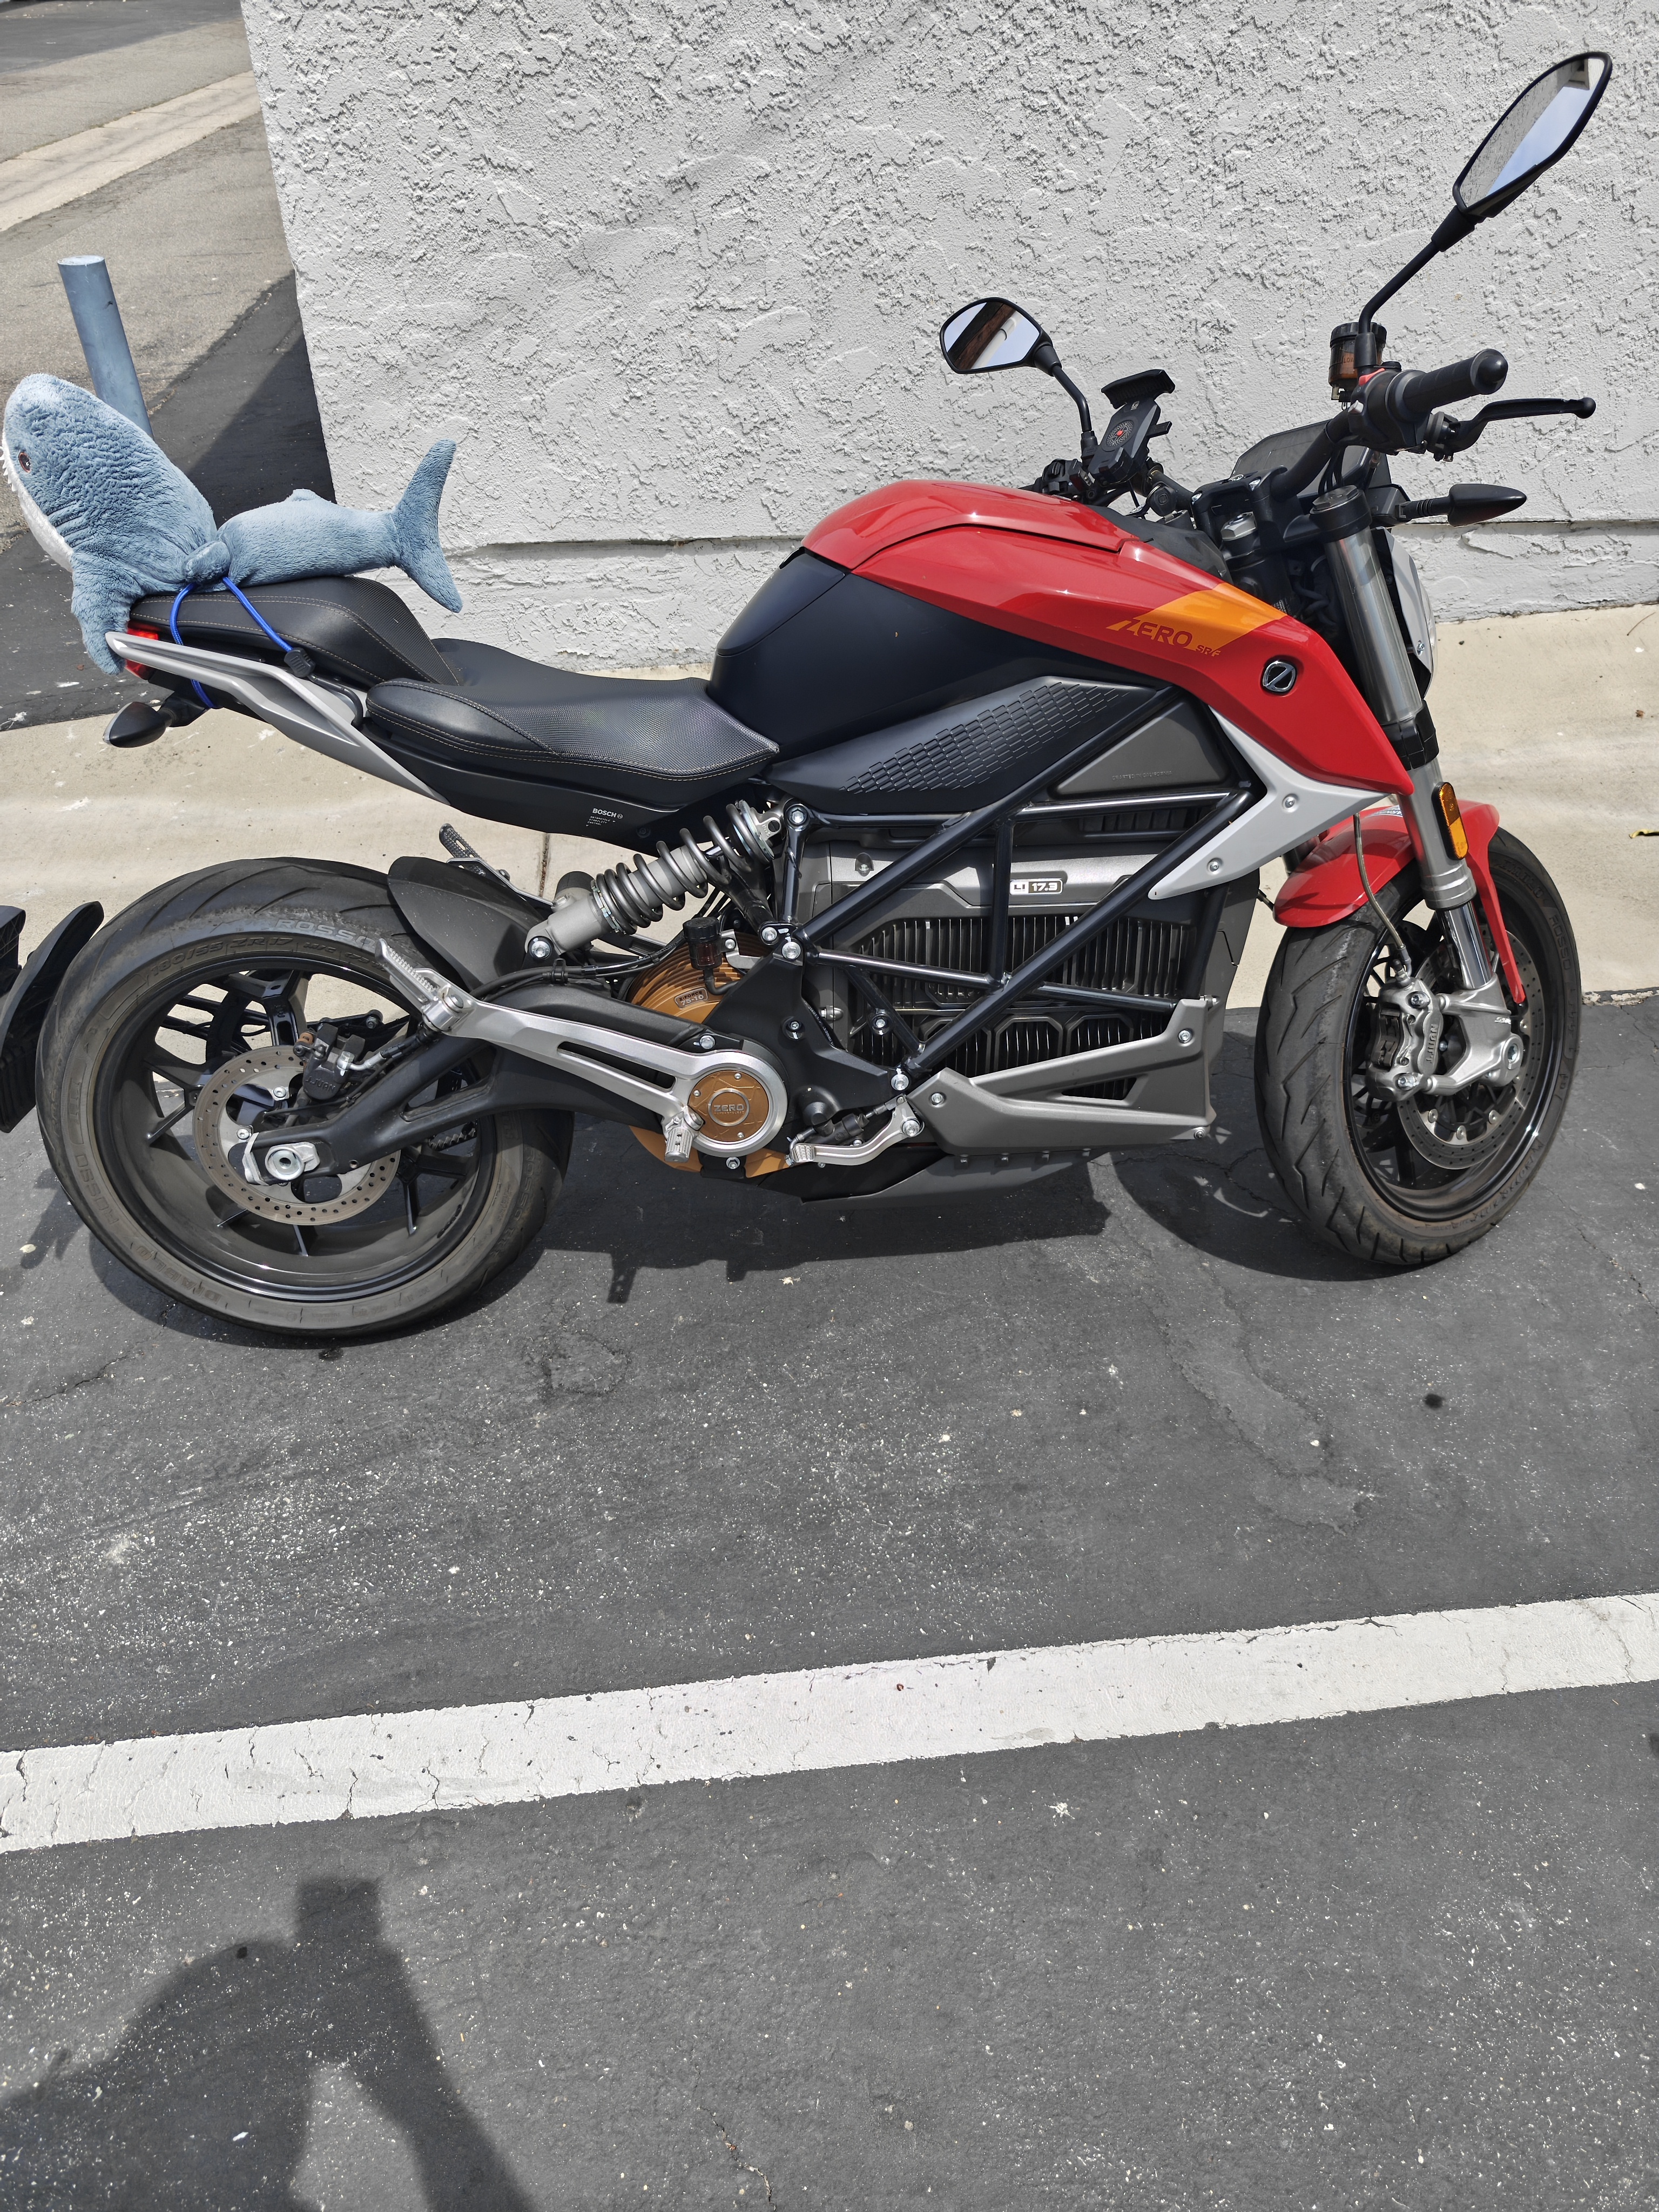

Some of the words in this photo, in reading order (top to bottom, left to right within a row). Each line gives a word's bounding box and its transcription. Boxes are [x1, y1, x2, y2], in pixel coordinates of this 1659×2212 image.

[1115, 618, 1192, 648] ZERO
[592, 808, 617, 818] BOSCH
[1031, 882, 1058, 892] 17.3
[275, 919, 376, 949] ROSSO
[1549, 914, 1571, 970] ROSSO
[151, 941, 224, 976] 180/55
[230, 937, 266, 948] ZR
[269, 938, 294, 946] 17
[679, 991, 702, 1001] Z-FORCE
[681, 994, 704, 1006] 75-10
[713, 1103, 744, 1112] ZERO
[75, 1154, 119, 1225] ROSSO
[514, 1148, 535, 1222] ROSSO
[136, 1245, 222, 1304] DIABLO
